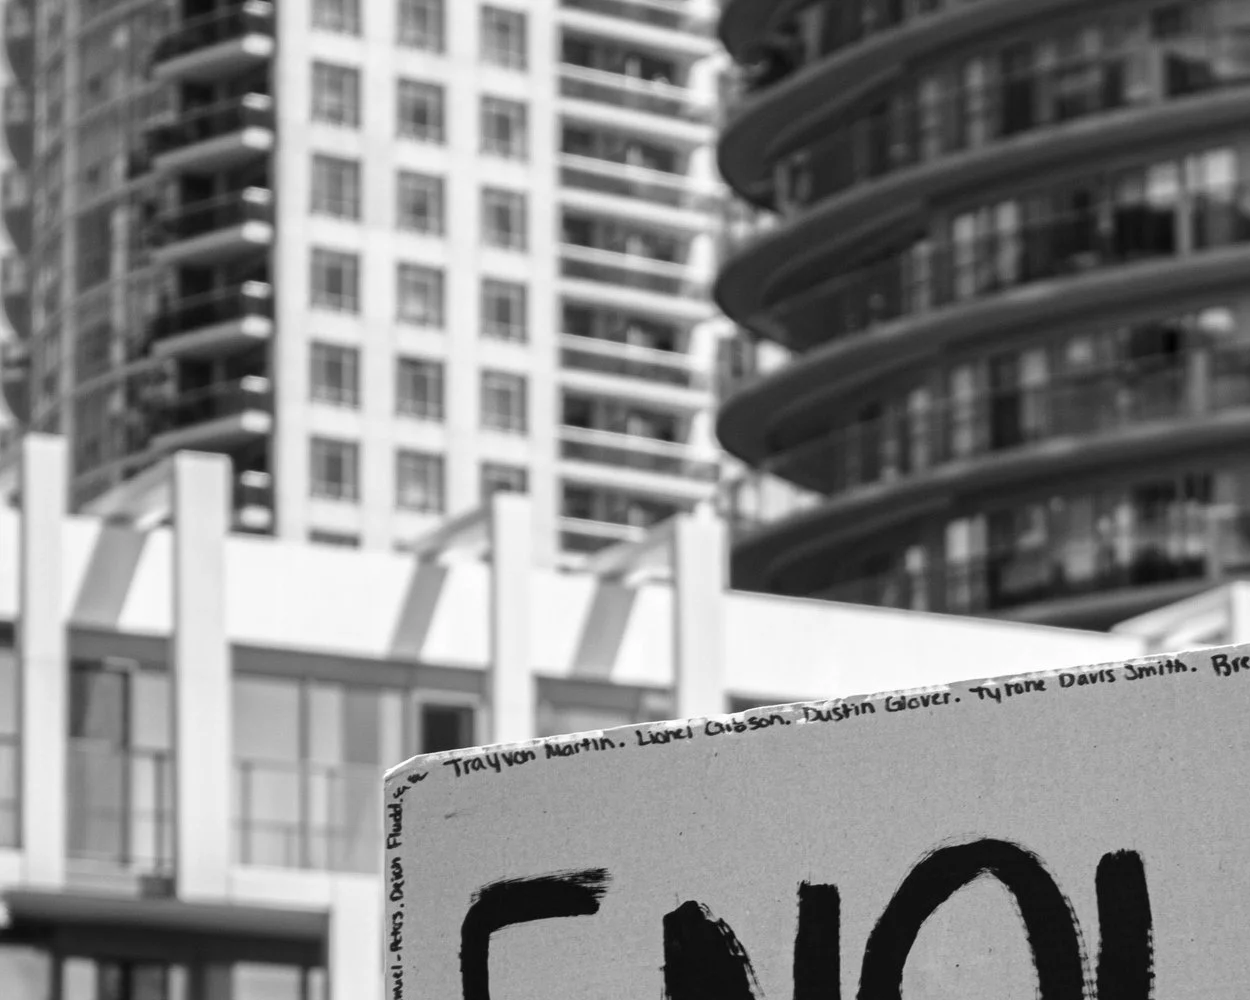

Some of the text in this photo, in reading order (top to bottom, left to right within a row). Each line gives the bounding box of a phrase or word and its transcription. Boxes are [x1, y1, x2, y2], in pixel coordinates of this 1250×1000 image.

[443, 750, 537, 779] Trayvon
[545, 736, 626, 761] Martin.
[635, 726, 694, 747] Lionel
[703, 711, 792, 736] Gibson.
[803, 700, 876, 723] Dustin
[885, 691, 961, 714] Glover.
[1059, 666, 1117, 688] Davis
[1124, 657, 1198, 681] Smith.
